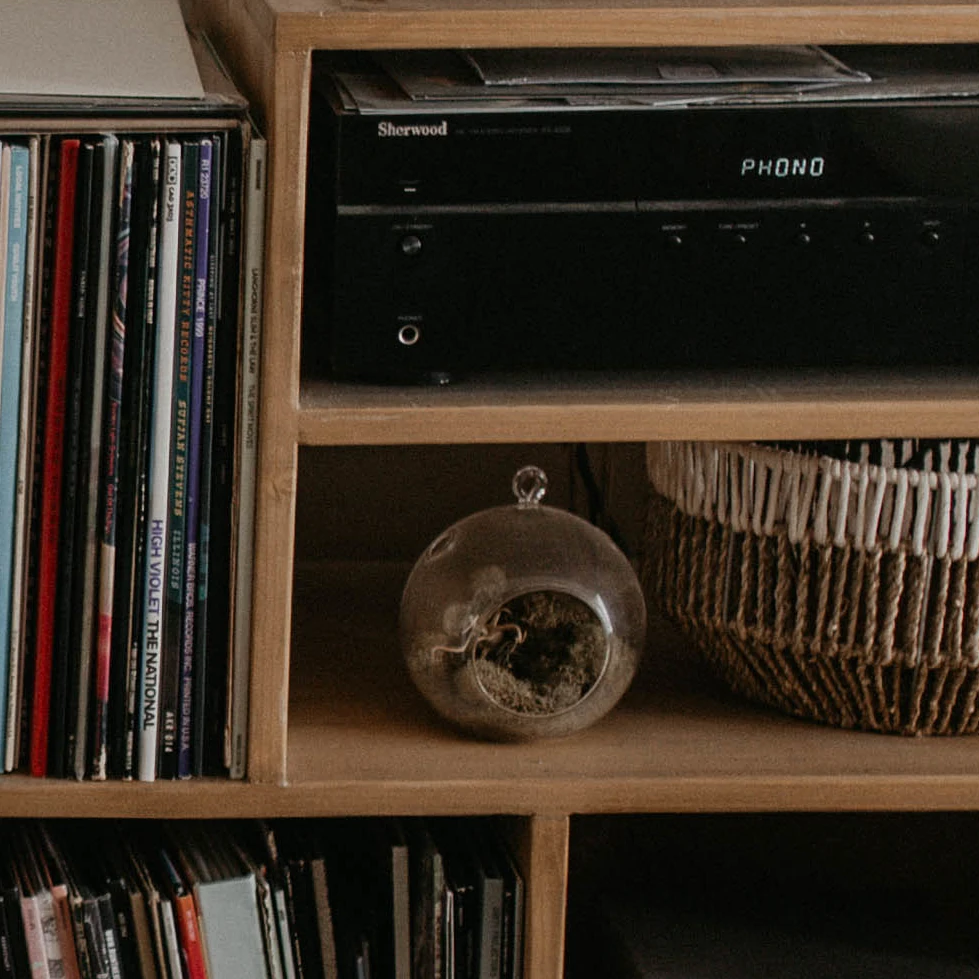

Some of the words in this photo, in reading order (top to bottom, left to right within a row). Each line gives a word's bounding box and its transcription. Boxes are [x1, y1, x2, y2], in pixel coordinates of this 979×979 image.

[377, 120, 448, 138] Sherwood
[740, 156, 825, 177] PHONO
[183, 190, 195, 270] ASTHMATIC
[181, 275, 192, 317] KITTY
[197, 278, 206, 312] PRINCE
[179, 320, 190, 382] RECORDS
[175, 399, 187, 452] SUFJAN
[173, 455, 185, 517] STEVENS
[149, 519, 164, 558] HIGH
[170, 529, 181, 590] ILLINOIS
[147, 561, 162, 615] VIOLET
[146, 620, 159, 650] THE
[183, 611, 195, 654] RECORDS
[142, 652, 158, 731] NATIONAL
[181, 676, 193, 715] PRINTED
